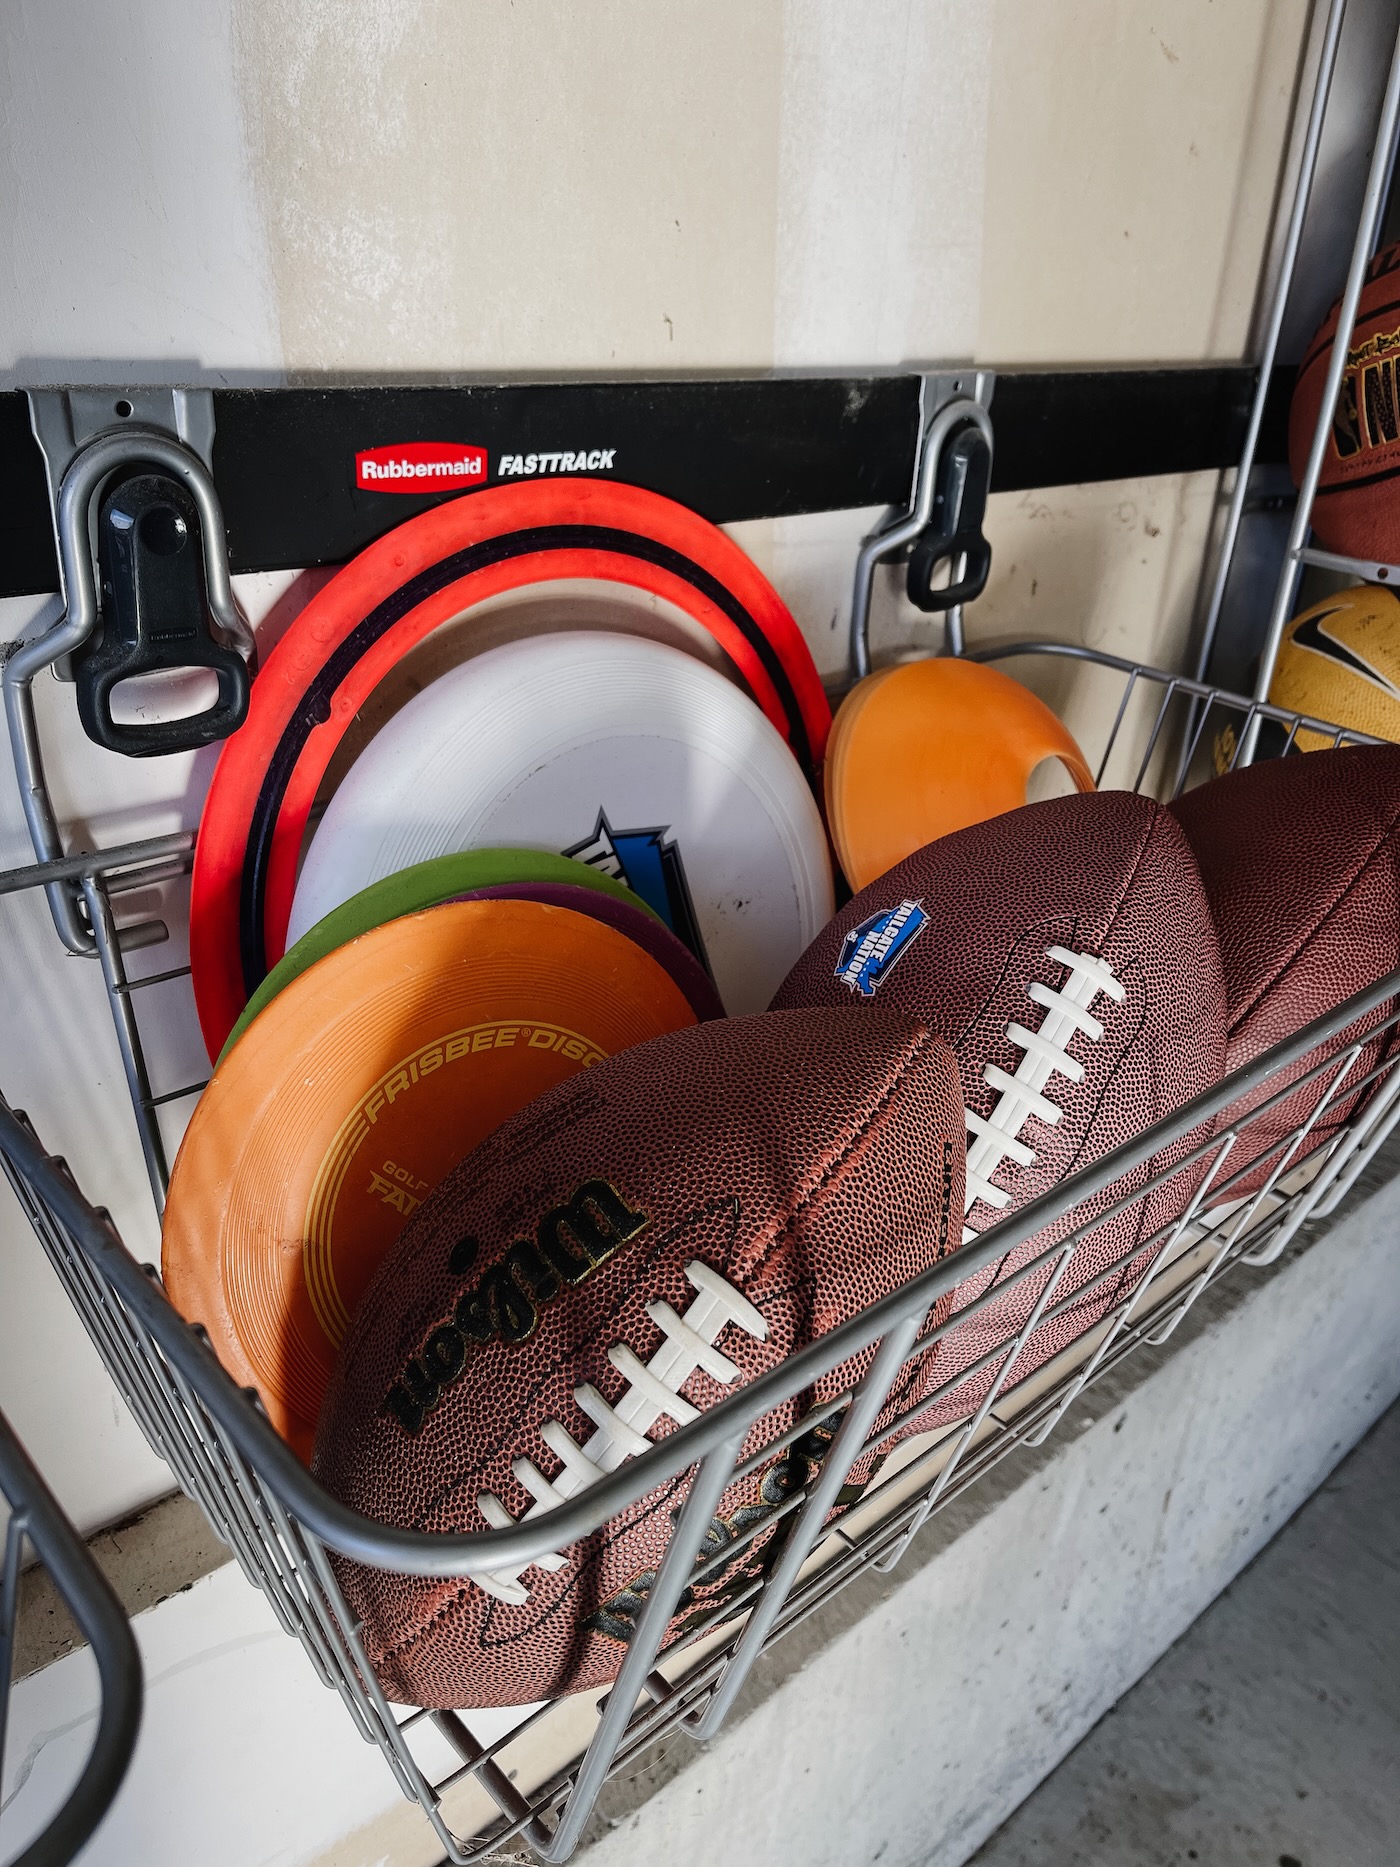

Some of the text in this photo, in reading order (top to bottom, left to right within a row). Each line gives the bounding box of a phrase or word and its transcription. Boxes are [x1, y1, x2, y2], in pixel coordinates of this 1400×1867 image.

[361, 449, 617, 479] Rubbermaid FASTTRACK
[843, 931, 882, 985] NATION
[870, 902, 917, 962] TAILGATE
[382, 1160, 428, 1191] GOLF
[384, 1178, 651, 1435] Wilson
